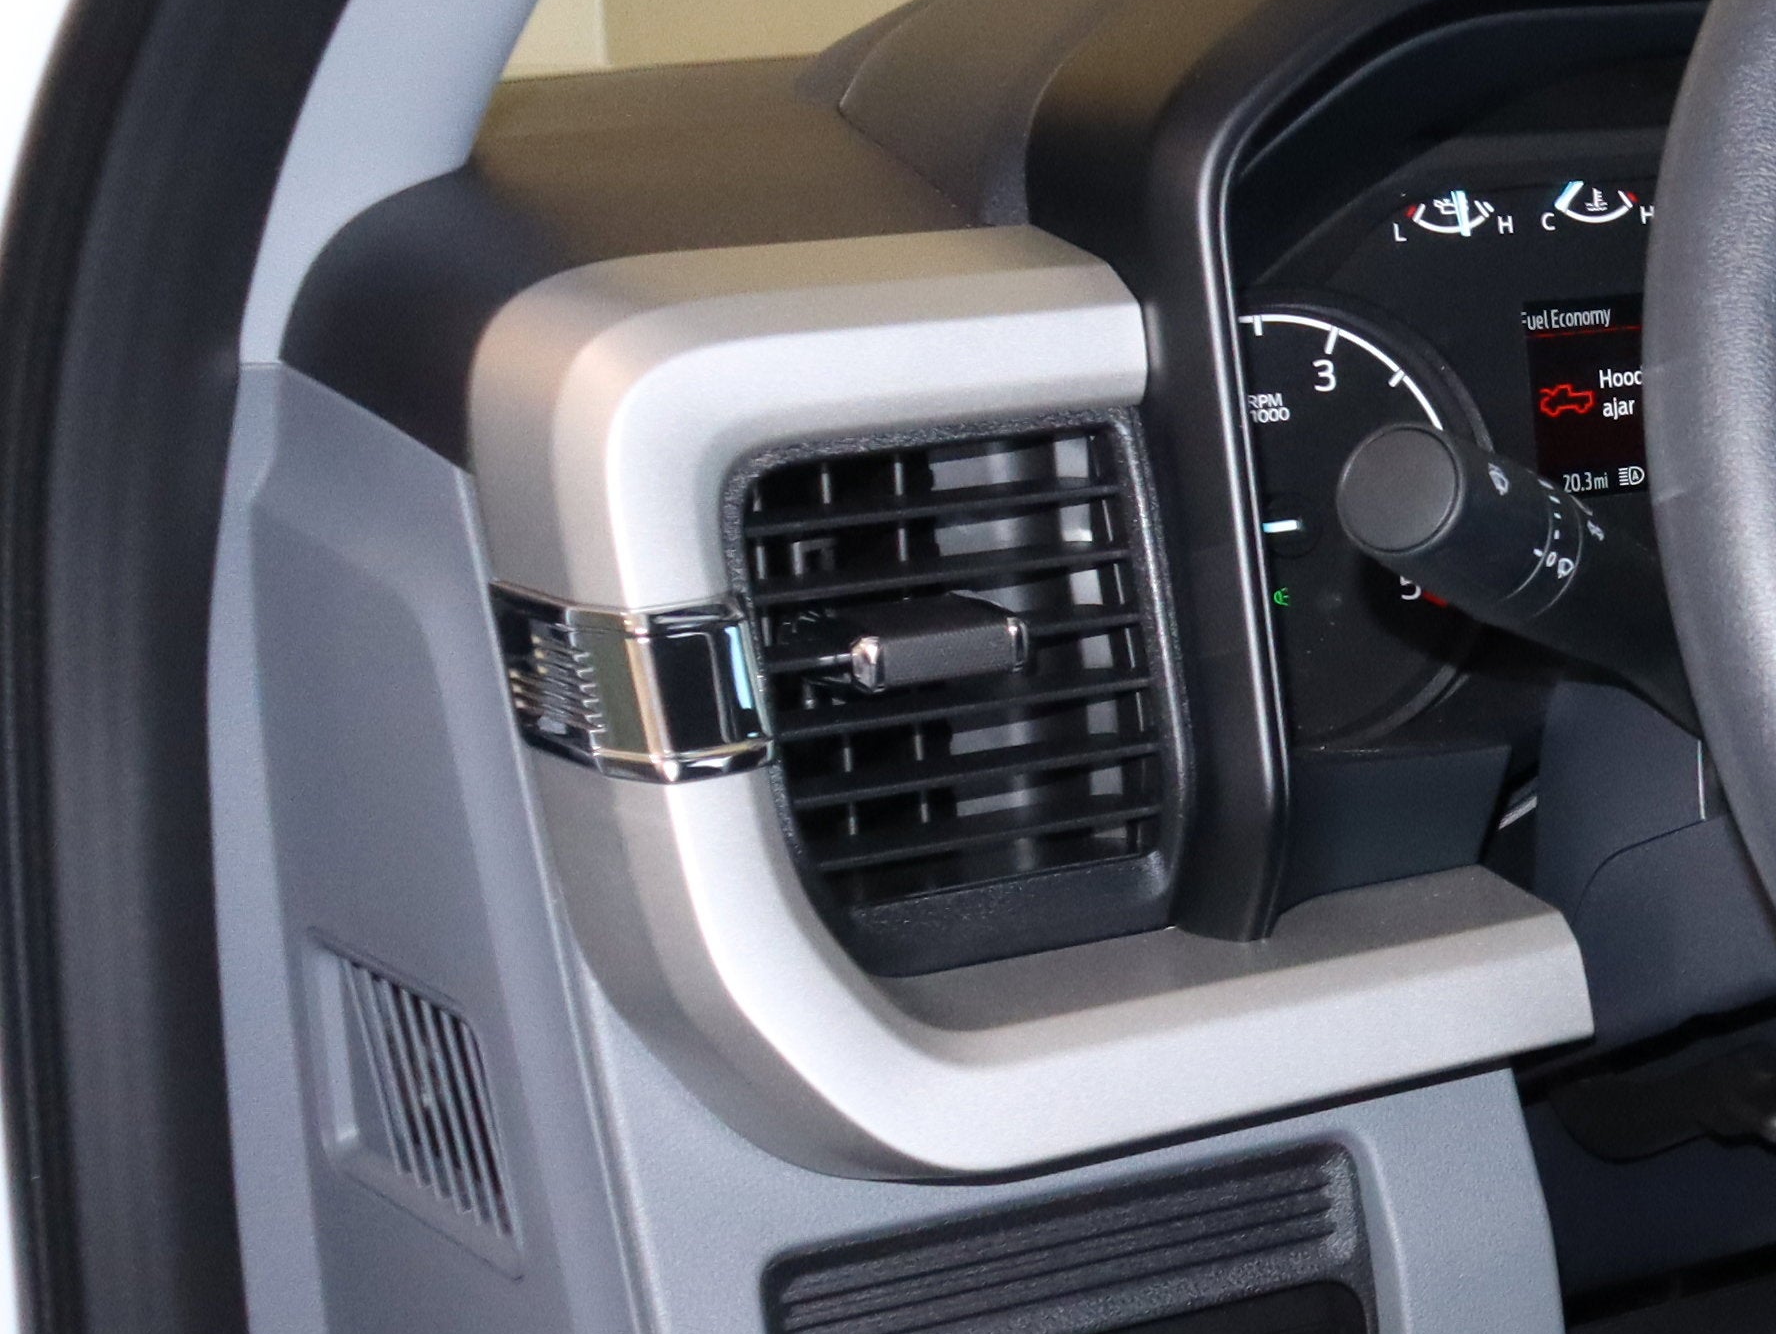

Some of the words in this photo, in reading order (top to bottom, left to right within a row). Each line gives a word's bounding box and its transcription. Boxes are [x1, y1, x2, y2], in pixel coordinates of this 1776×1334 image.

[1541, 212, 1556, 231] C
[1639, 205, 1655, 224] H
[1393, 222, 1407, 242] L
[1497, 215, 1514, 235] H
[1551, 308, 1611, 329] Economy
[1312, 358, 1337, 393] 3
[1247, 393, 1283, 408] RPM
[1602, 397, 1635, 420] ajar
[1399, 575, 1422, 602] 5
